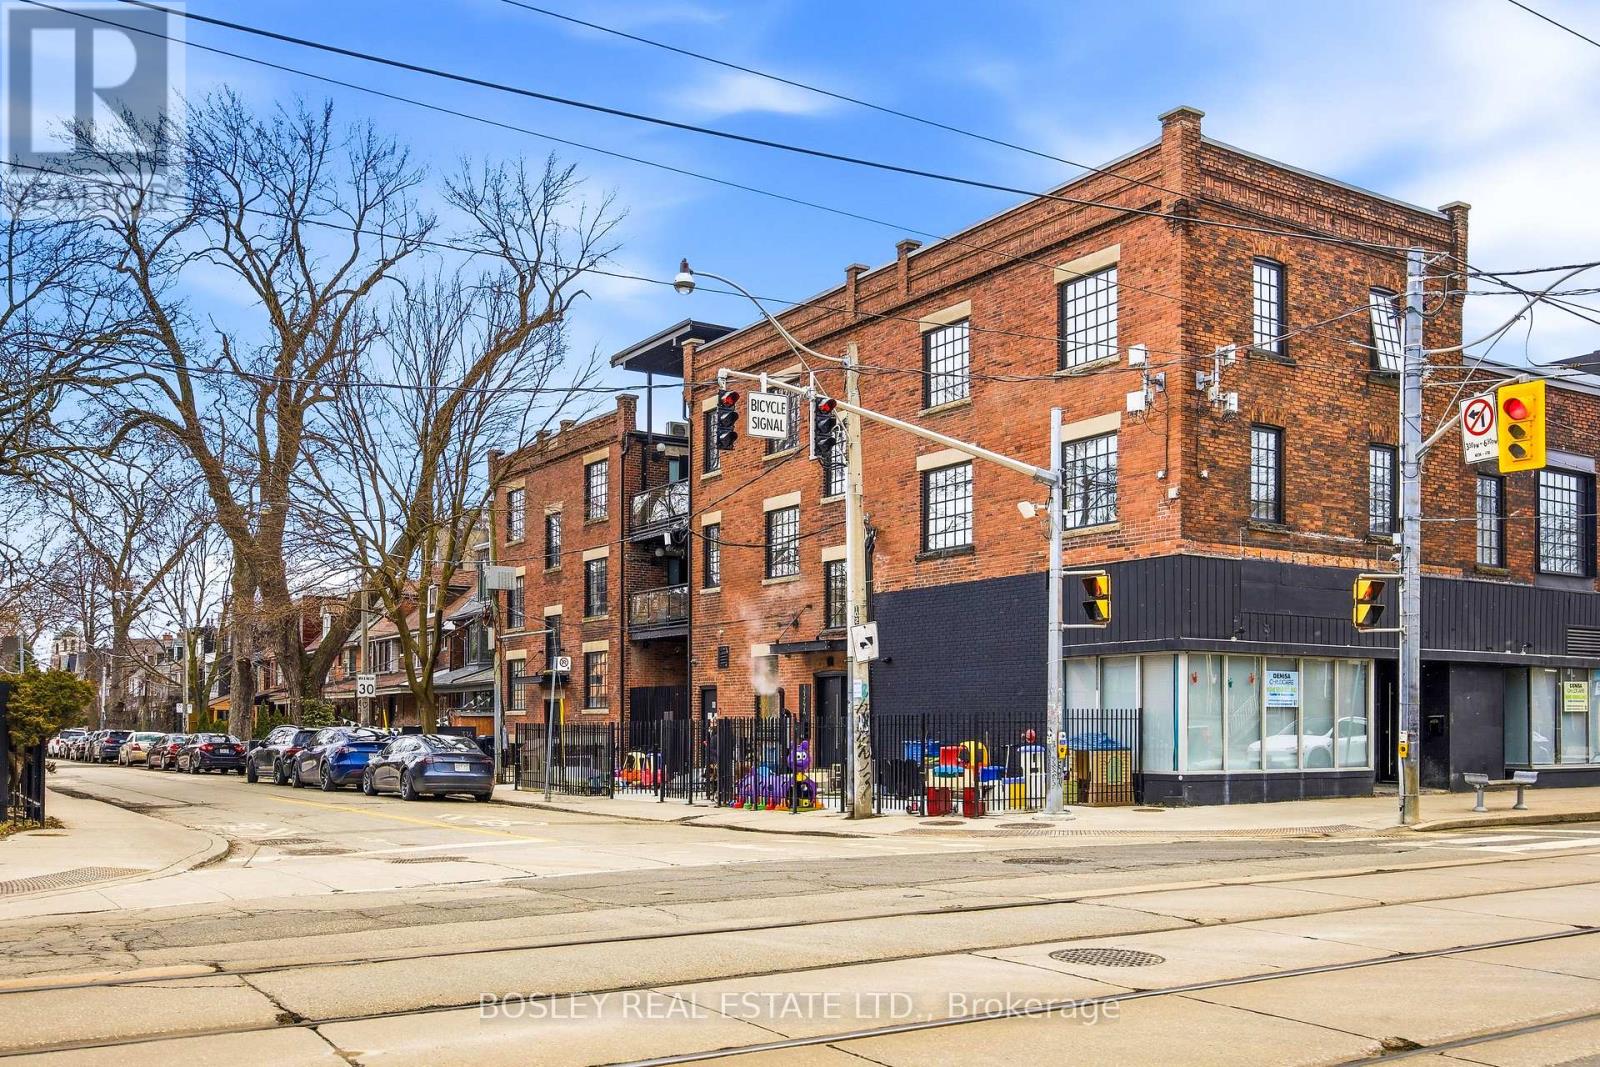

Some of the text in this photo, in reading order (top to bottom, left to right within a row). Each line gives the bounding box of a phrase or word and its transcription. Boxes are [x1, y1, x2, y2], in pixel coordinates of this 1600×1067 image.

[751, 398, 786, 414] BICYCLE
[751, 416, 785, 432] SIGNAL
[359, 683, 374, 694] 30
